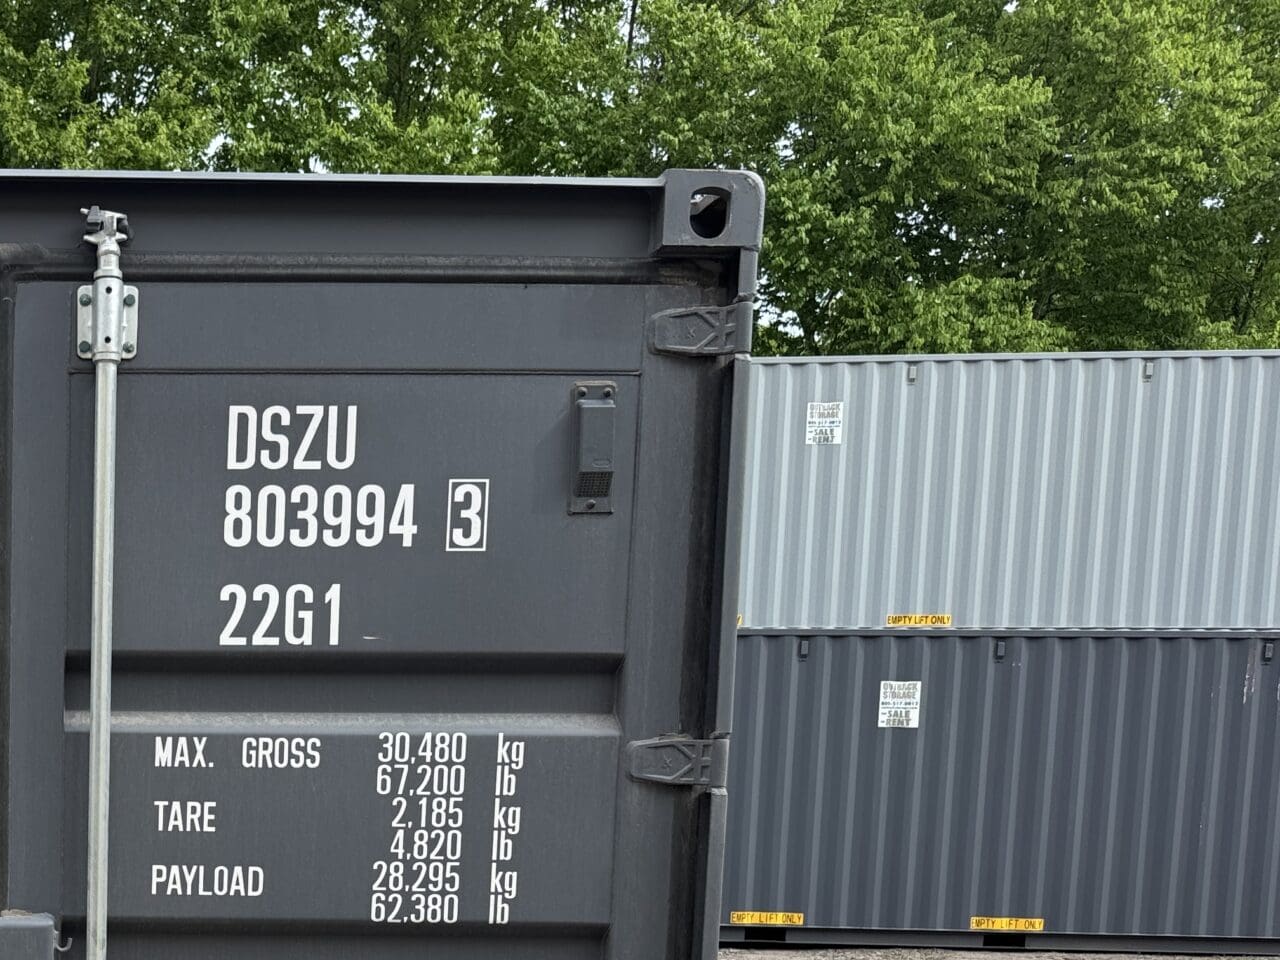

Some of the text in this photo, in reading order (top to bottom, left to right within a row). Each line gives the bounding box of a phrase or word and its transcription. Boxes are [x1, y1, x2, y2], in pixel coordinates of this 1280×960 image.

[226, 405, 358, 470] DSZU
[223, 483, 482, 548] 803994 3
[219, 583, 341, 646] 22G1
[887, 615, 913, 624] EMPTY
[930, 615, 951, 625] ONLY
[154, 736, 321, 769] MAX. GROSS
[378, 731, 525, 770] 30,480 kg
[376, 764, 517, 796] 67,200 lb
[154, 800, 217, 832] TARE
[391, 796, 521, 835] 2,185 kg
[390, 829, 513, 861] 4,820 lb
[151, 864, 264, 897] PAYLOAD
[372, 860, 518, 899] 28,295 kg
[370, 892, 510, 924] 62,380 lb
[732, 912, 802, 924] EMPTY LIFT ONLY
[1000, 919, 1020, 929] LIFT
[1024, 919, 1043, 930] ONLY
